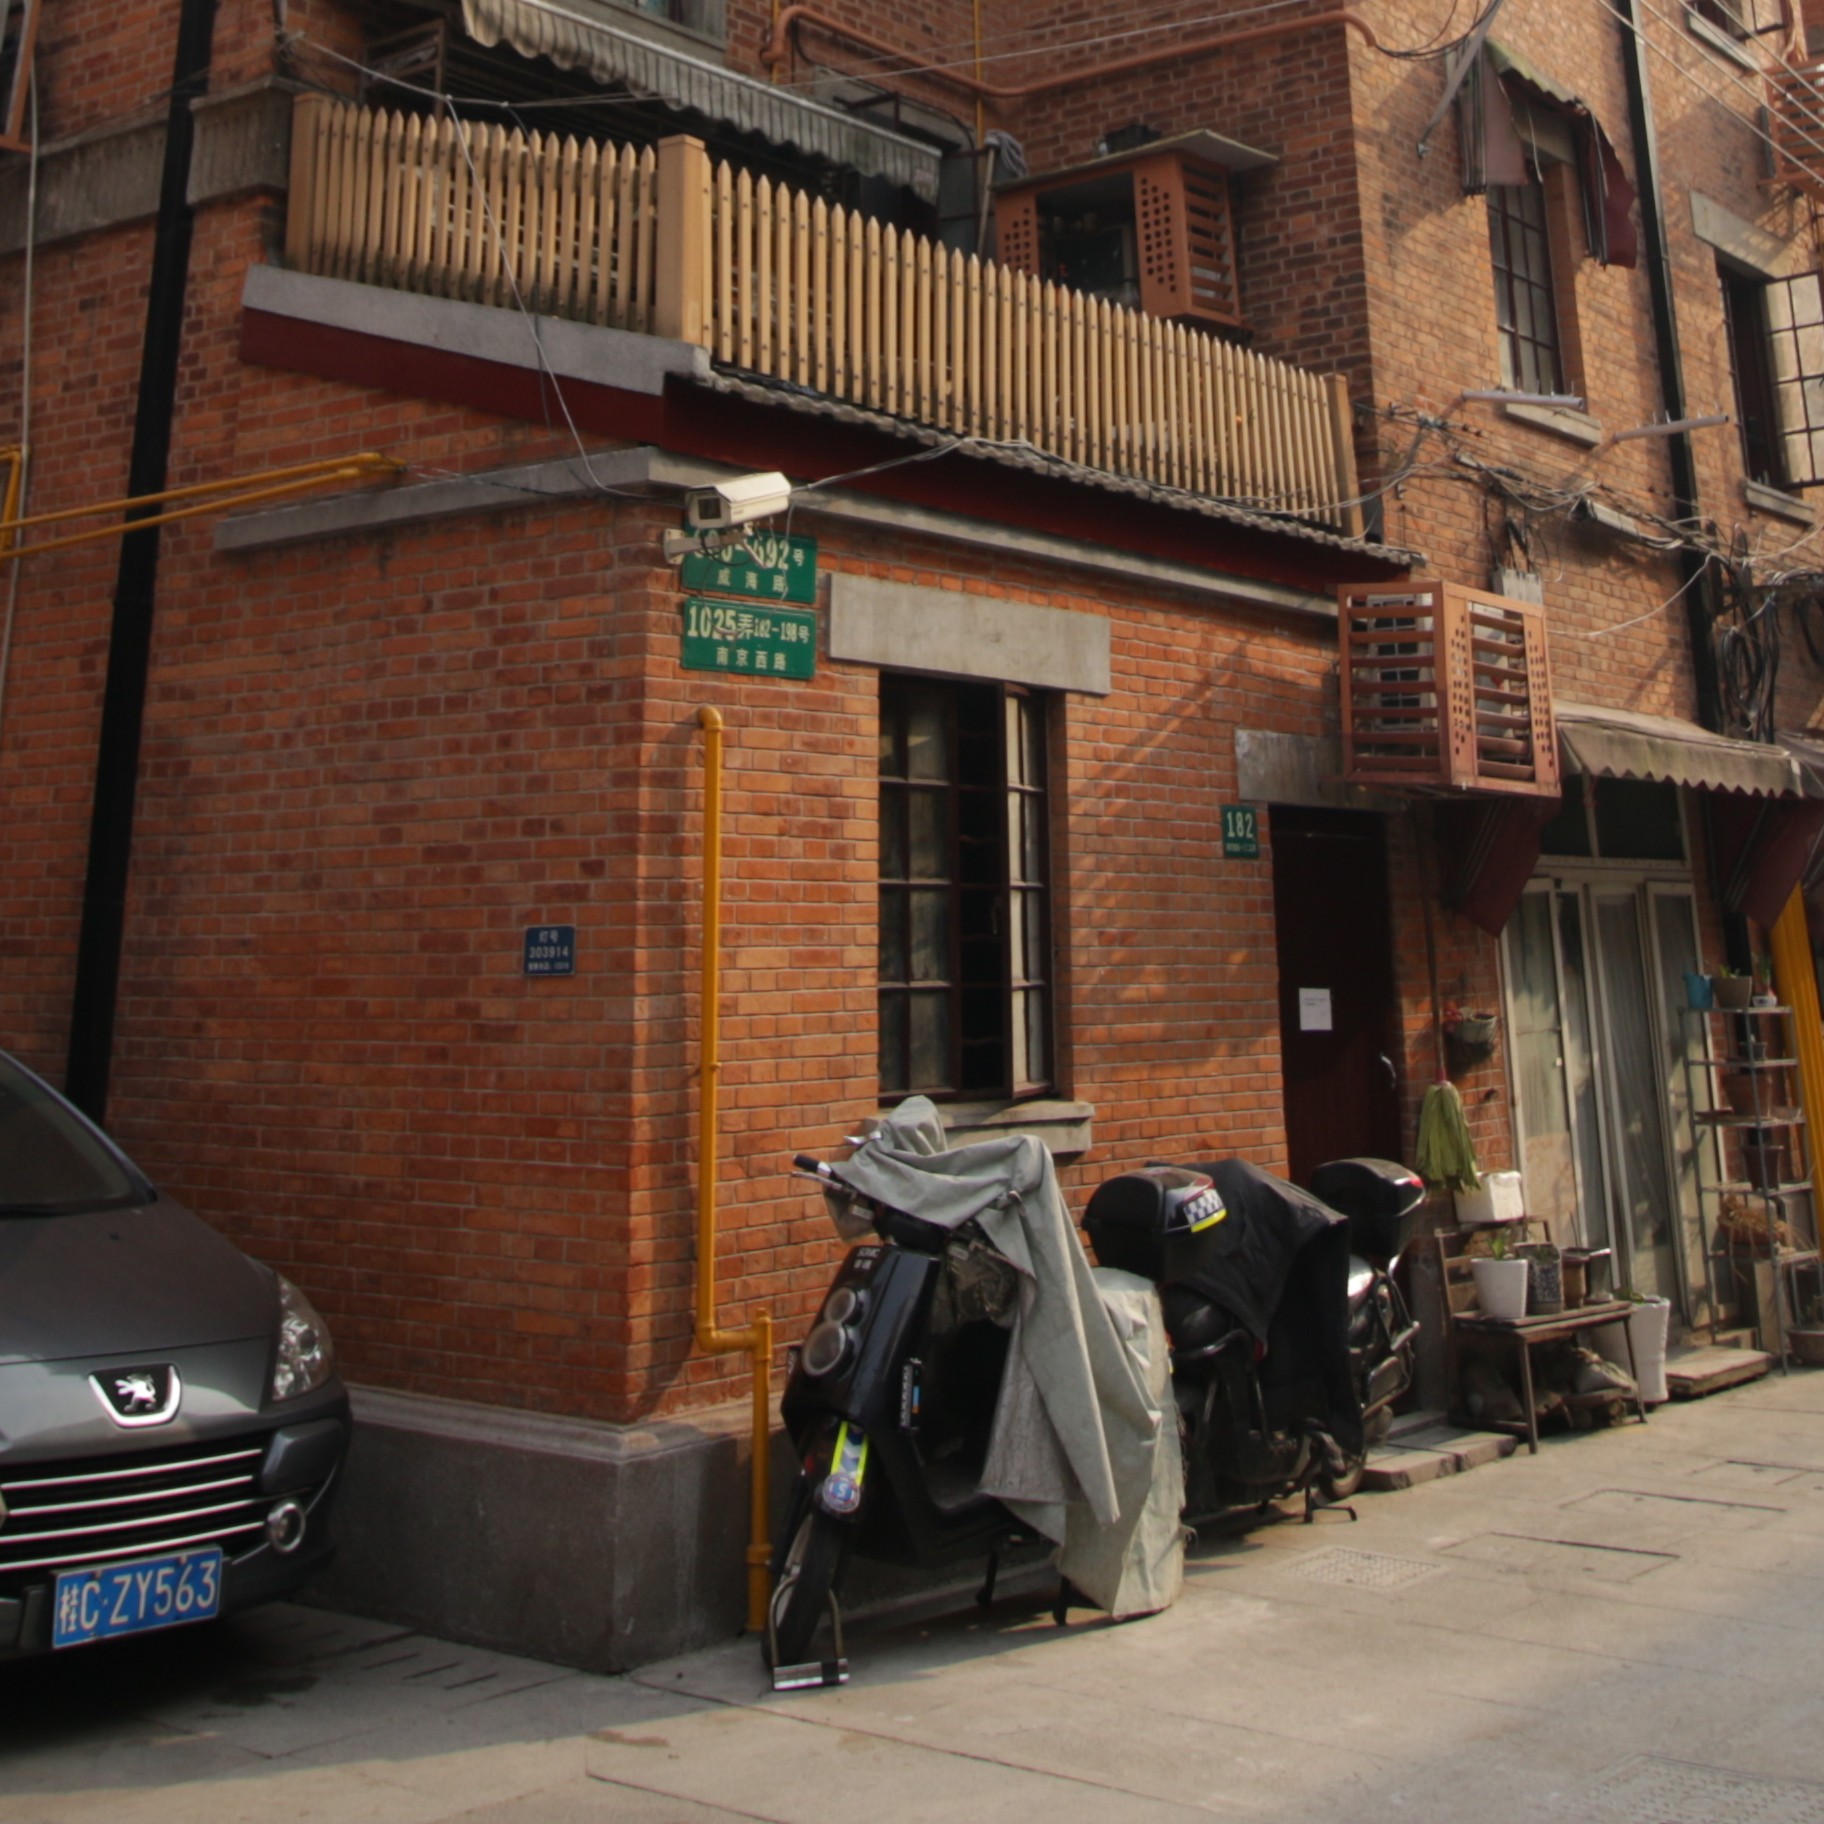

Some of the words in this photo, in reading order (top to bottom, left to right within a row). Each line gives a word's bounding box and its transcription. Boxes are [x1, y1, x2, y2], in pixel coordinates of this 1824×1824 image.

[716, 646, 787, 671] 南京西路
[1226, 811, 1254, 839] 182
